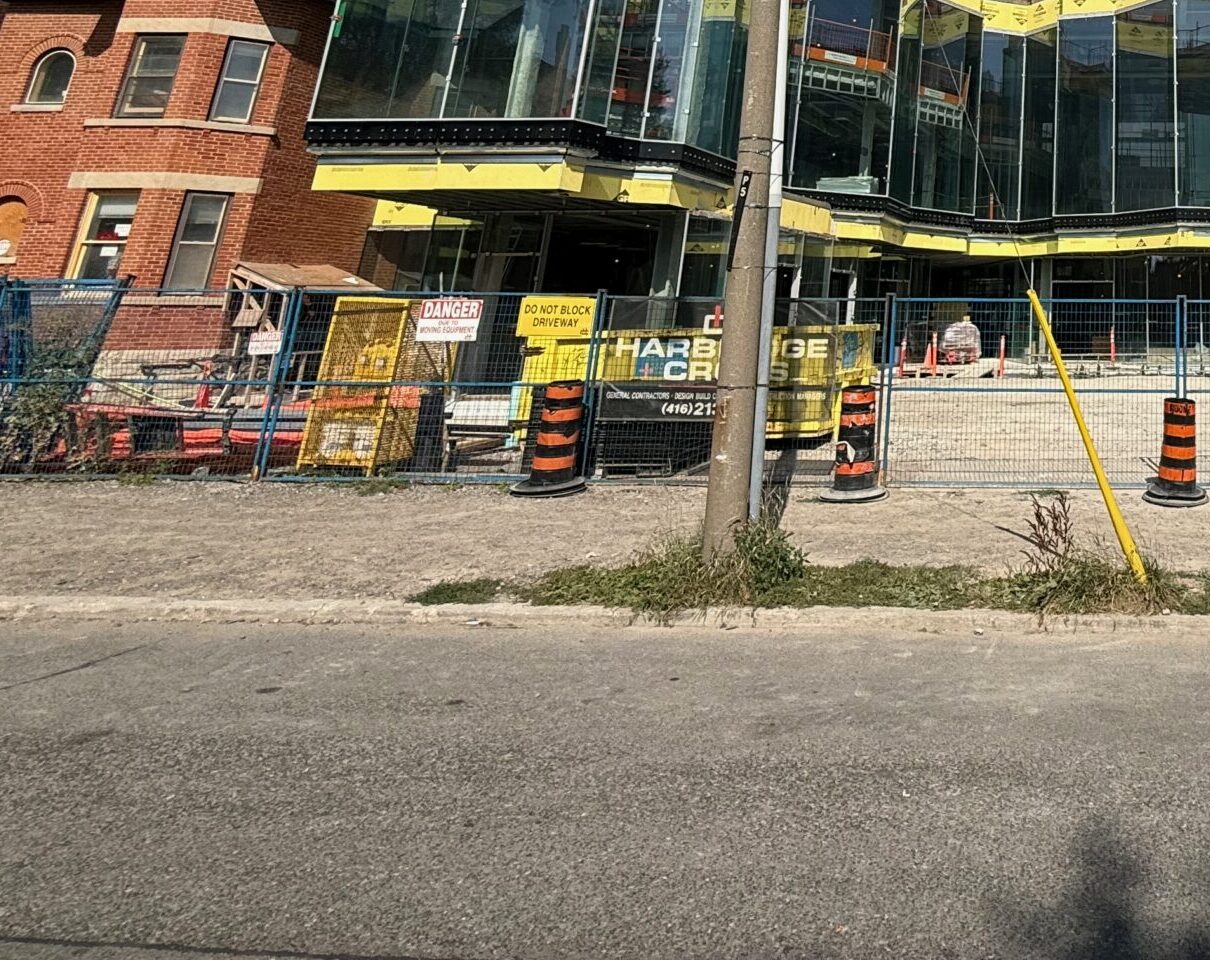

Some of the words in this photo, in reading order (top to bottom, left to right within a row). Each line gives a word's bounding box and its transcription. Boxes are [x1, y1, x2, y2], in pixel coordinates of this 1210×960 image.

[423, 302, 481, 319] DANGER
[525, 305, 538, 314] DO
[540, 305, 558, 314] NOT
[560, 305, 591, 315] BLOCK
[532, 317, 580, 328] DRIVEWAY
